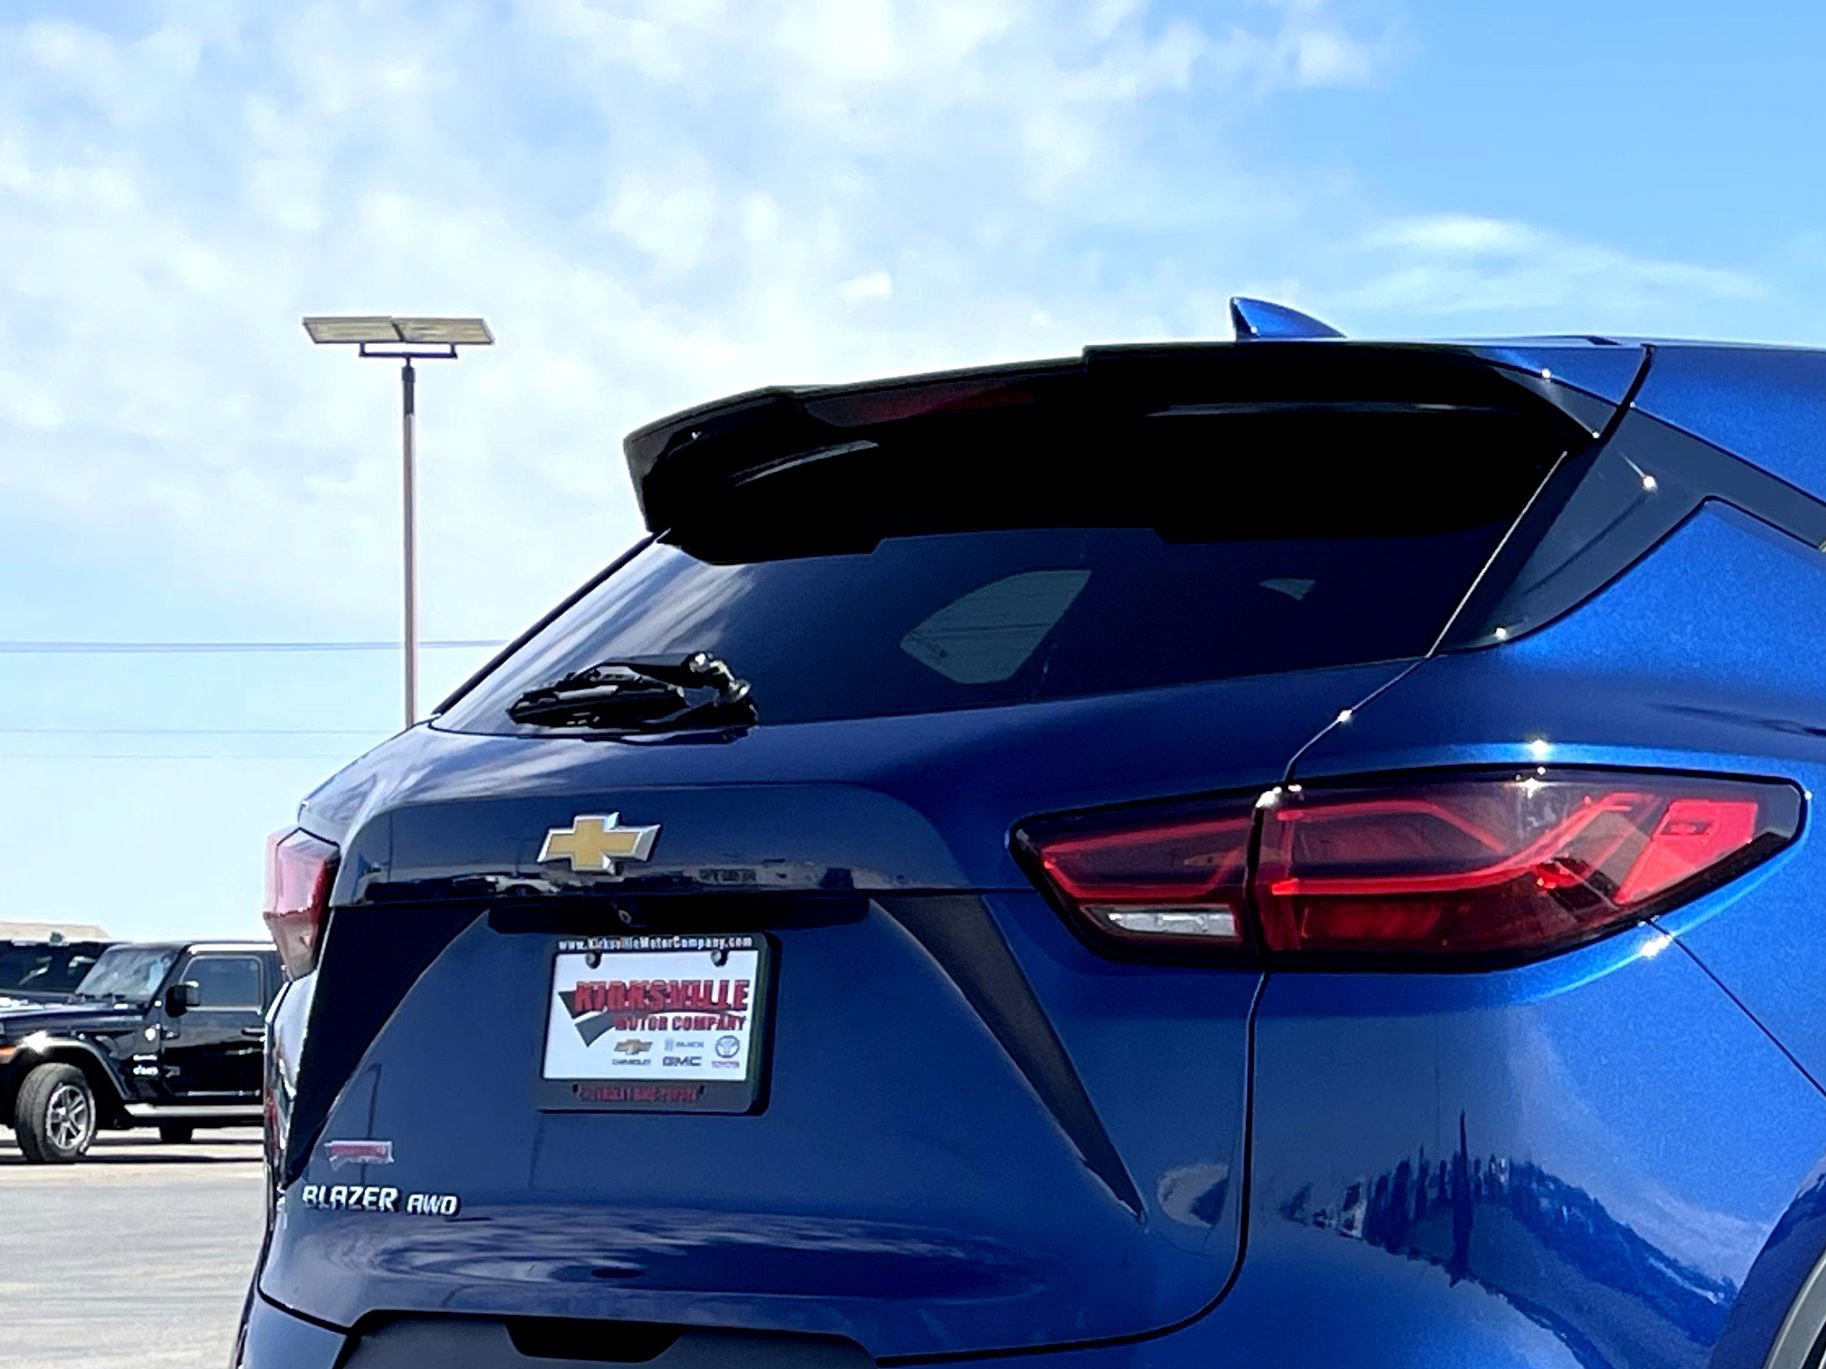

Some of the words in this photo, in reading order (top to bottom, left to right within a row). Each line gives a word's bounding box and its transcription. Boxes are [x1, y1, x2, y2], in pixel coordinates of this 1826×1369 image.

[558, 936, 752, 950] www.KirksvilleMotorCompany.com
[573, 980, 750, 1011] KIRKSVILLE
[614, 1016, 669, 1031] MOTOR
[672, 1015, 747, 1031] COMPANY
[662, 1055, 702, 1067] GMC
[302, 1185, 399, 1213] BLAZER
[406, 1193, 459, 1215] AWD
